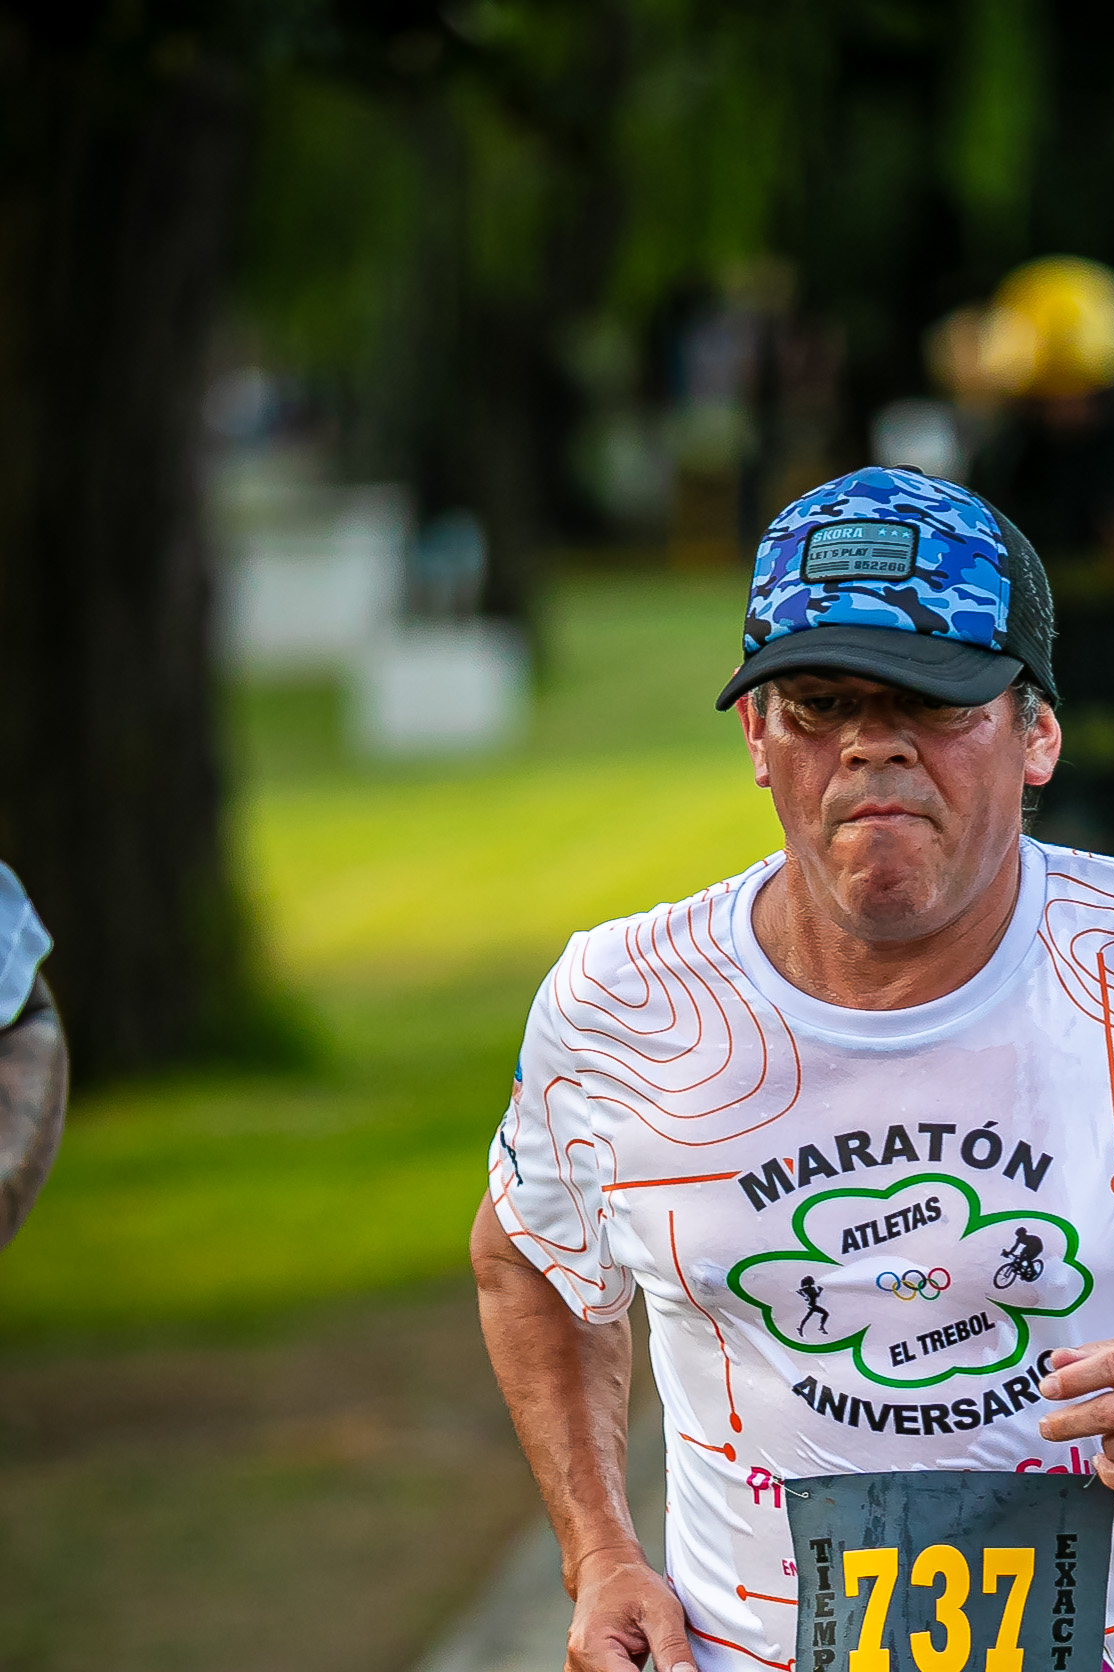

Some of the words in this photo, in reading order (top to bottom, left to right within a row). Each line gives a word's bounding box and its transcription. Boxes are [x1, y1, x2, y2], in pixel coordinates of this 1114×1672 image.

[812, 527, 864, 543] SKORA
[840, 547, 869, 557] PLAY
[738, 1120, 1054, 1213] MARATÓN
[841, 1195, 943, 1255] ATLETAS
[888, 1340, 918, 1368] EL
[916, 1311, 996, 1356] TREBOL
